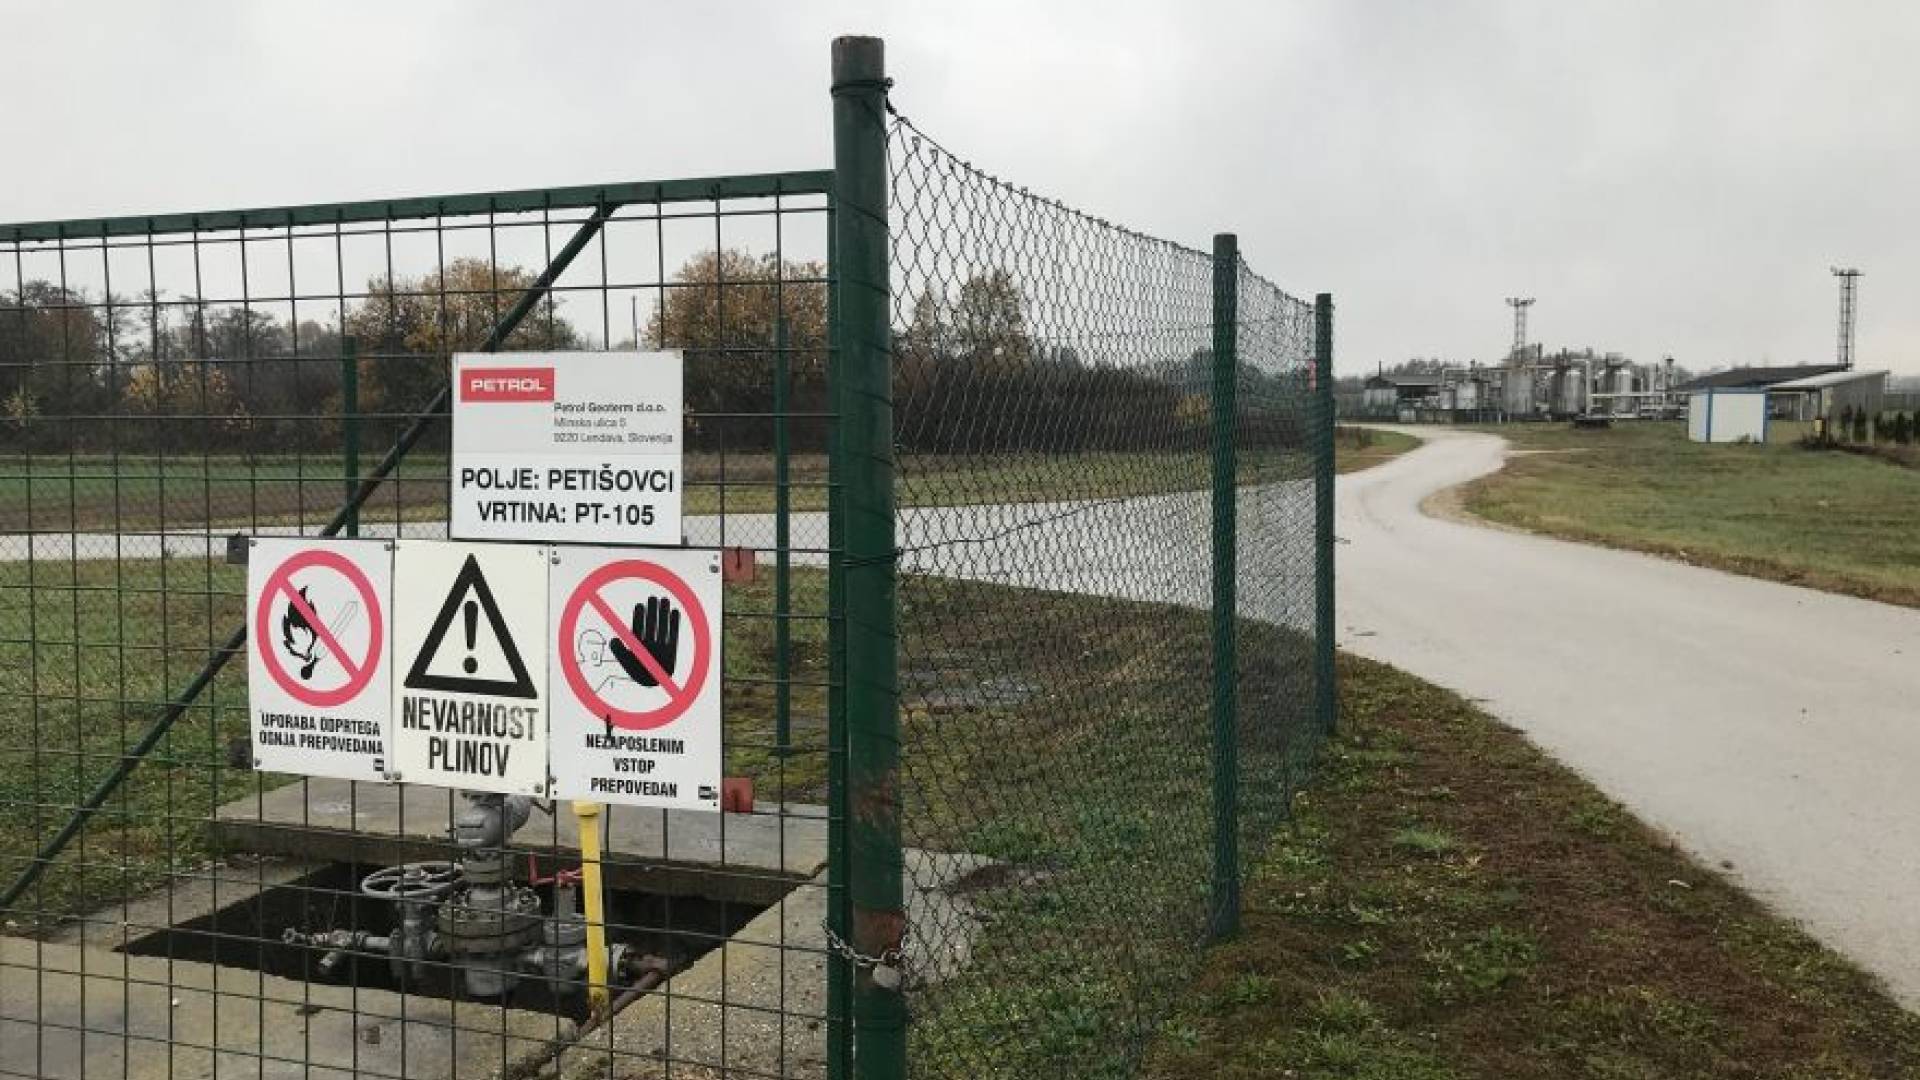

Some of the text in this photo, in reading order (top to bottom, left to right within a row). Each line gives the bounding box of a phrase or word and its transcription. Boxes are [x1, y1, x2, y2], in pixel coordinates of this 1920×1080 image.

[470, 378, 547, 392] PETROL
[554, 402, 585, 412] Petrol
[588, 402, 633, 412] Geoterm
[593, 418, 618, 428] ulica
[554, 433, 578, 442] 9220
[628, 433, 673, 444] Slovenija
[461, 463, 673, 492] POLJE: PETIŠOVCI
[478, 501, 655, 525] VRTINA: PT-105
[261, 711, 380, 736] UPORABA ODPRTEGA
[403, 696, 539, 741] NEVARNOST
[259, 730, 384, 755] OGNJA PREPOVEDANA
[586, 733, 684, 755] NEZAPOSLENIM
[428, 736, 510, 777] PLINOV
[613, 758, 655, 774] VSTOP
[590, 777, 677, 798] PREPOVEDAN
